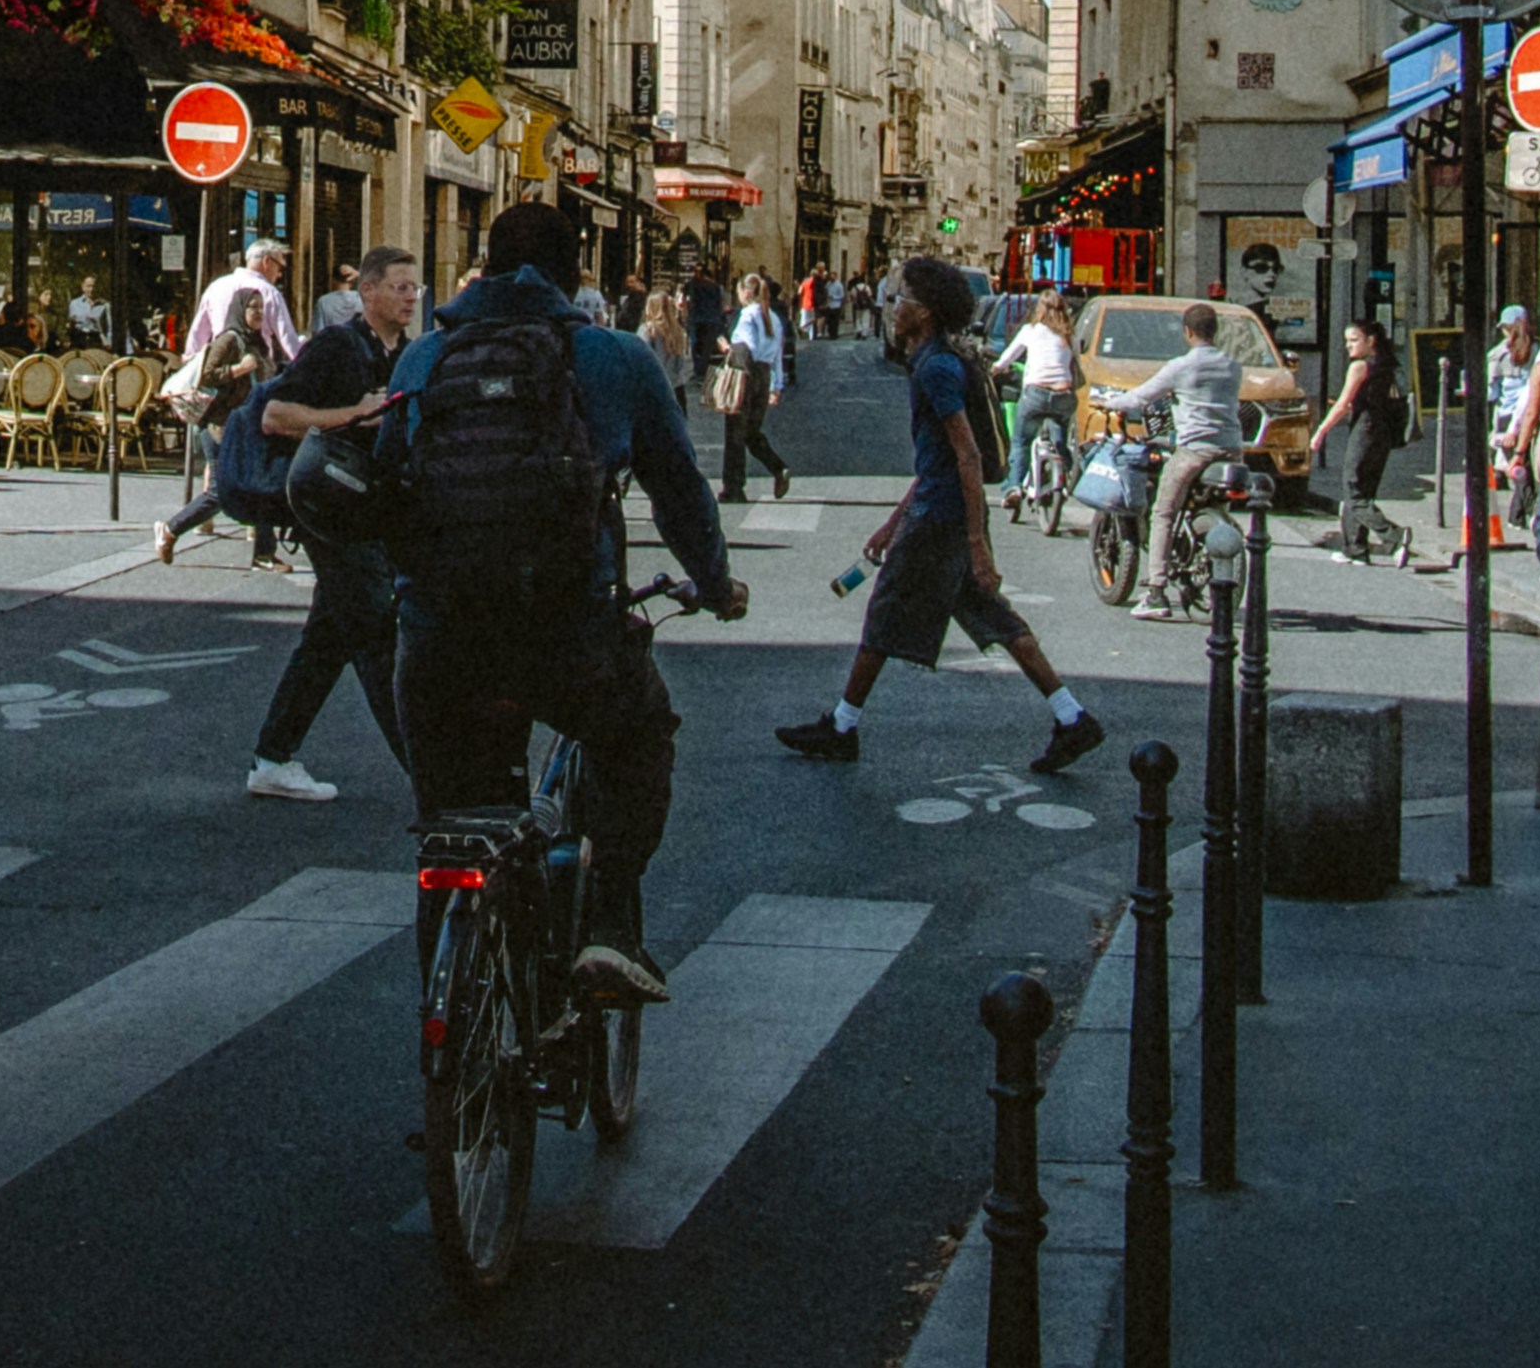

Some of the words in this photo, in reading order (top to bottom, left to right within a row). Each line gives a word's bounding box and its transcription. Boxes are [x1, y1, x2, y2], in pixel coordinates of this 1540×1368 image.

[510, 24, 568, 39] CLAUDE
[510, 40, 575, 61] AUBRY
[278, 97, 308, 116] BAR
[435, 106, 474, 149] PRESSE
[563, 156, 599, 174] BAR
